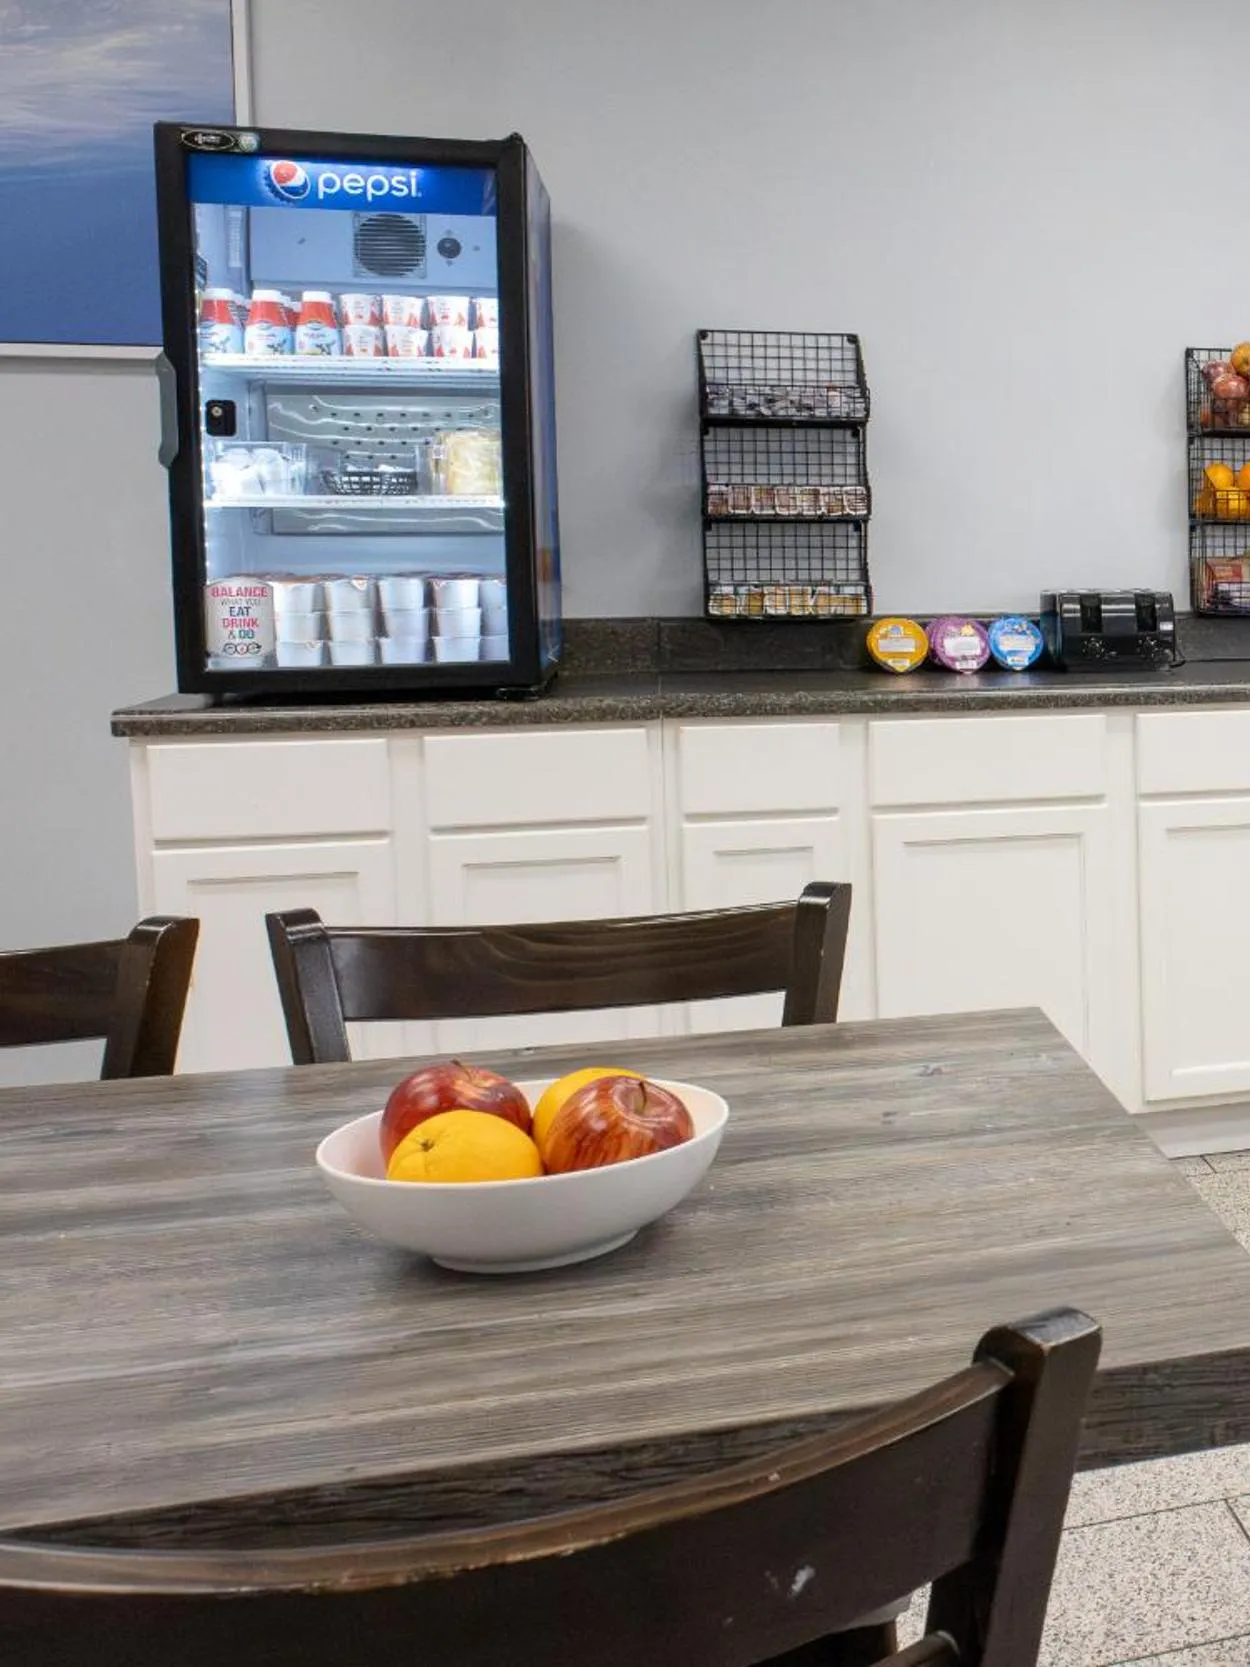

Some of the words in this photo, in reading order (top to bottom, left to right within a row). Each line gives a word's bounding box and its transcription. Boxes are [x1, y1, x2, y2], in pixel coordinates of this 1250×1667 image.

[318, 170, 417, 201] pepsi
[211, 586, 268, 598] BALANCE
[229, 606, 252, 617] EAT
[222, 618, 259, 628] DRINK
